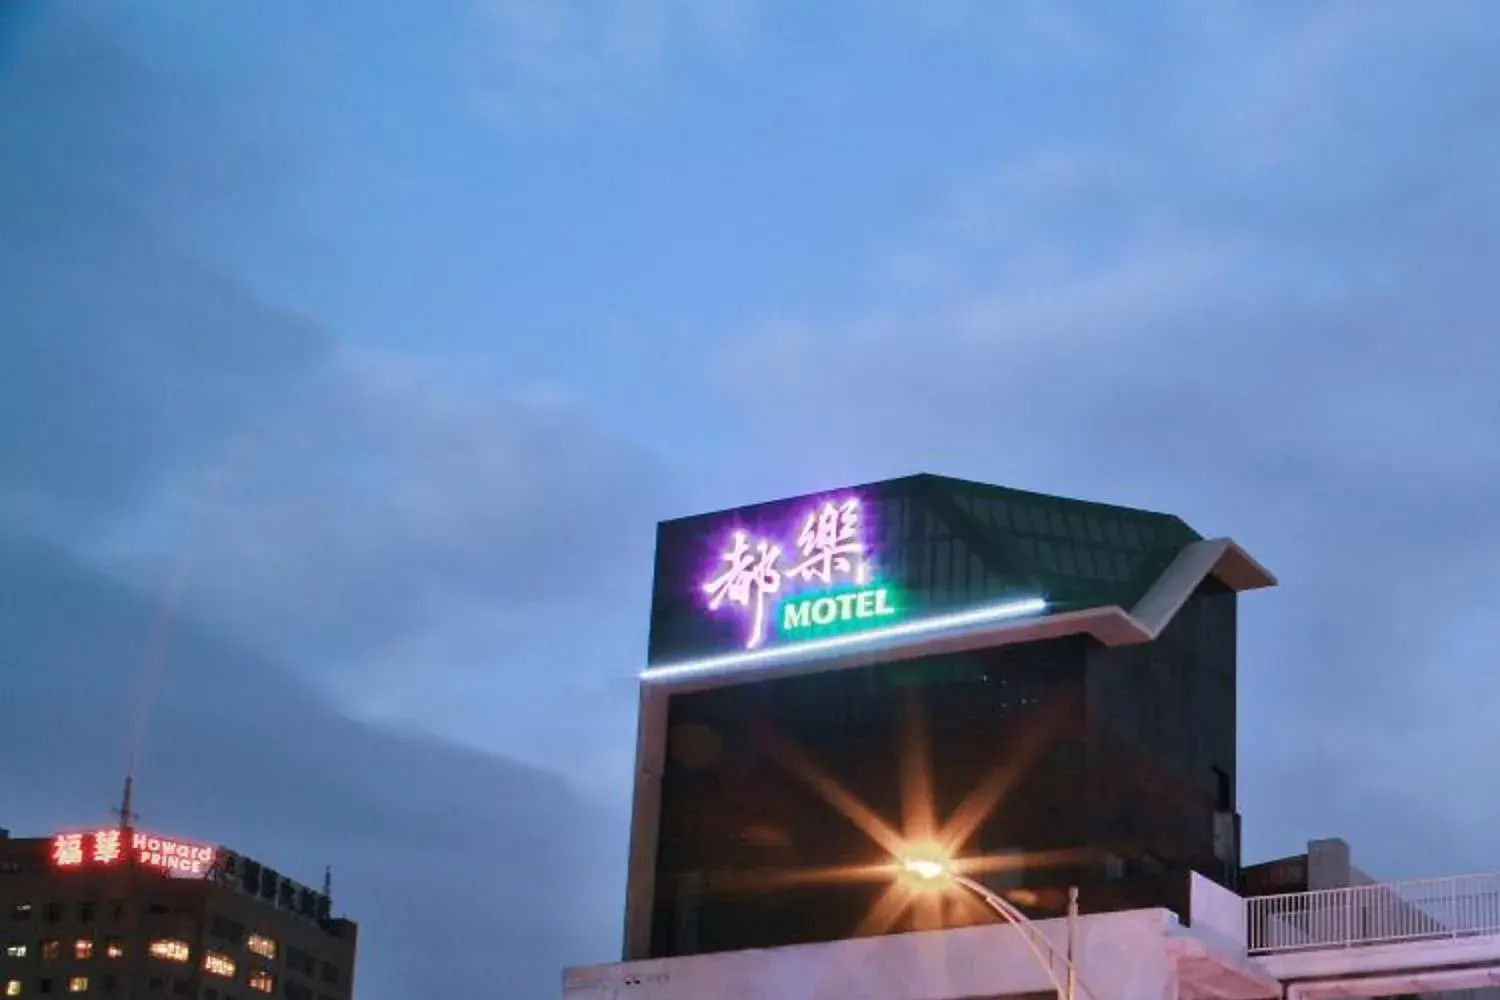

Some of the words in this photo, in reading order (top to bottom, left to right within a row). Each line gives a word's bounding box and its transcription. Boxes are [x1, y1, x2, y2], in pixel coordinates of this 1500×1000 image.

[703, 497, 867, 648] 都樂
[783, 588, 895, 631] MOTEL
[53, 830, 120, 865] 福華
[140, 851, 201, 873] PRINCE
